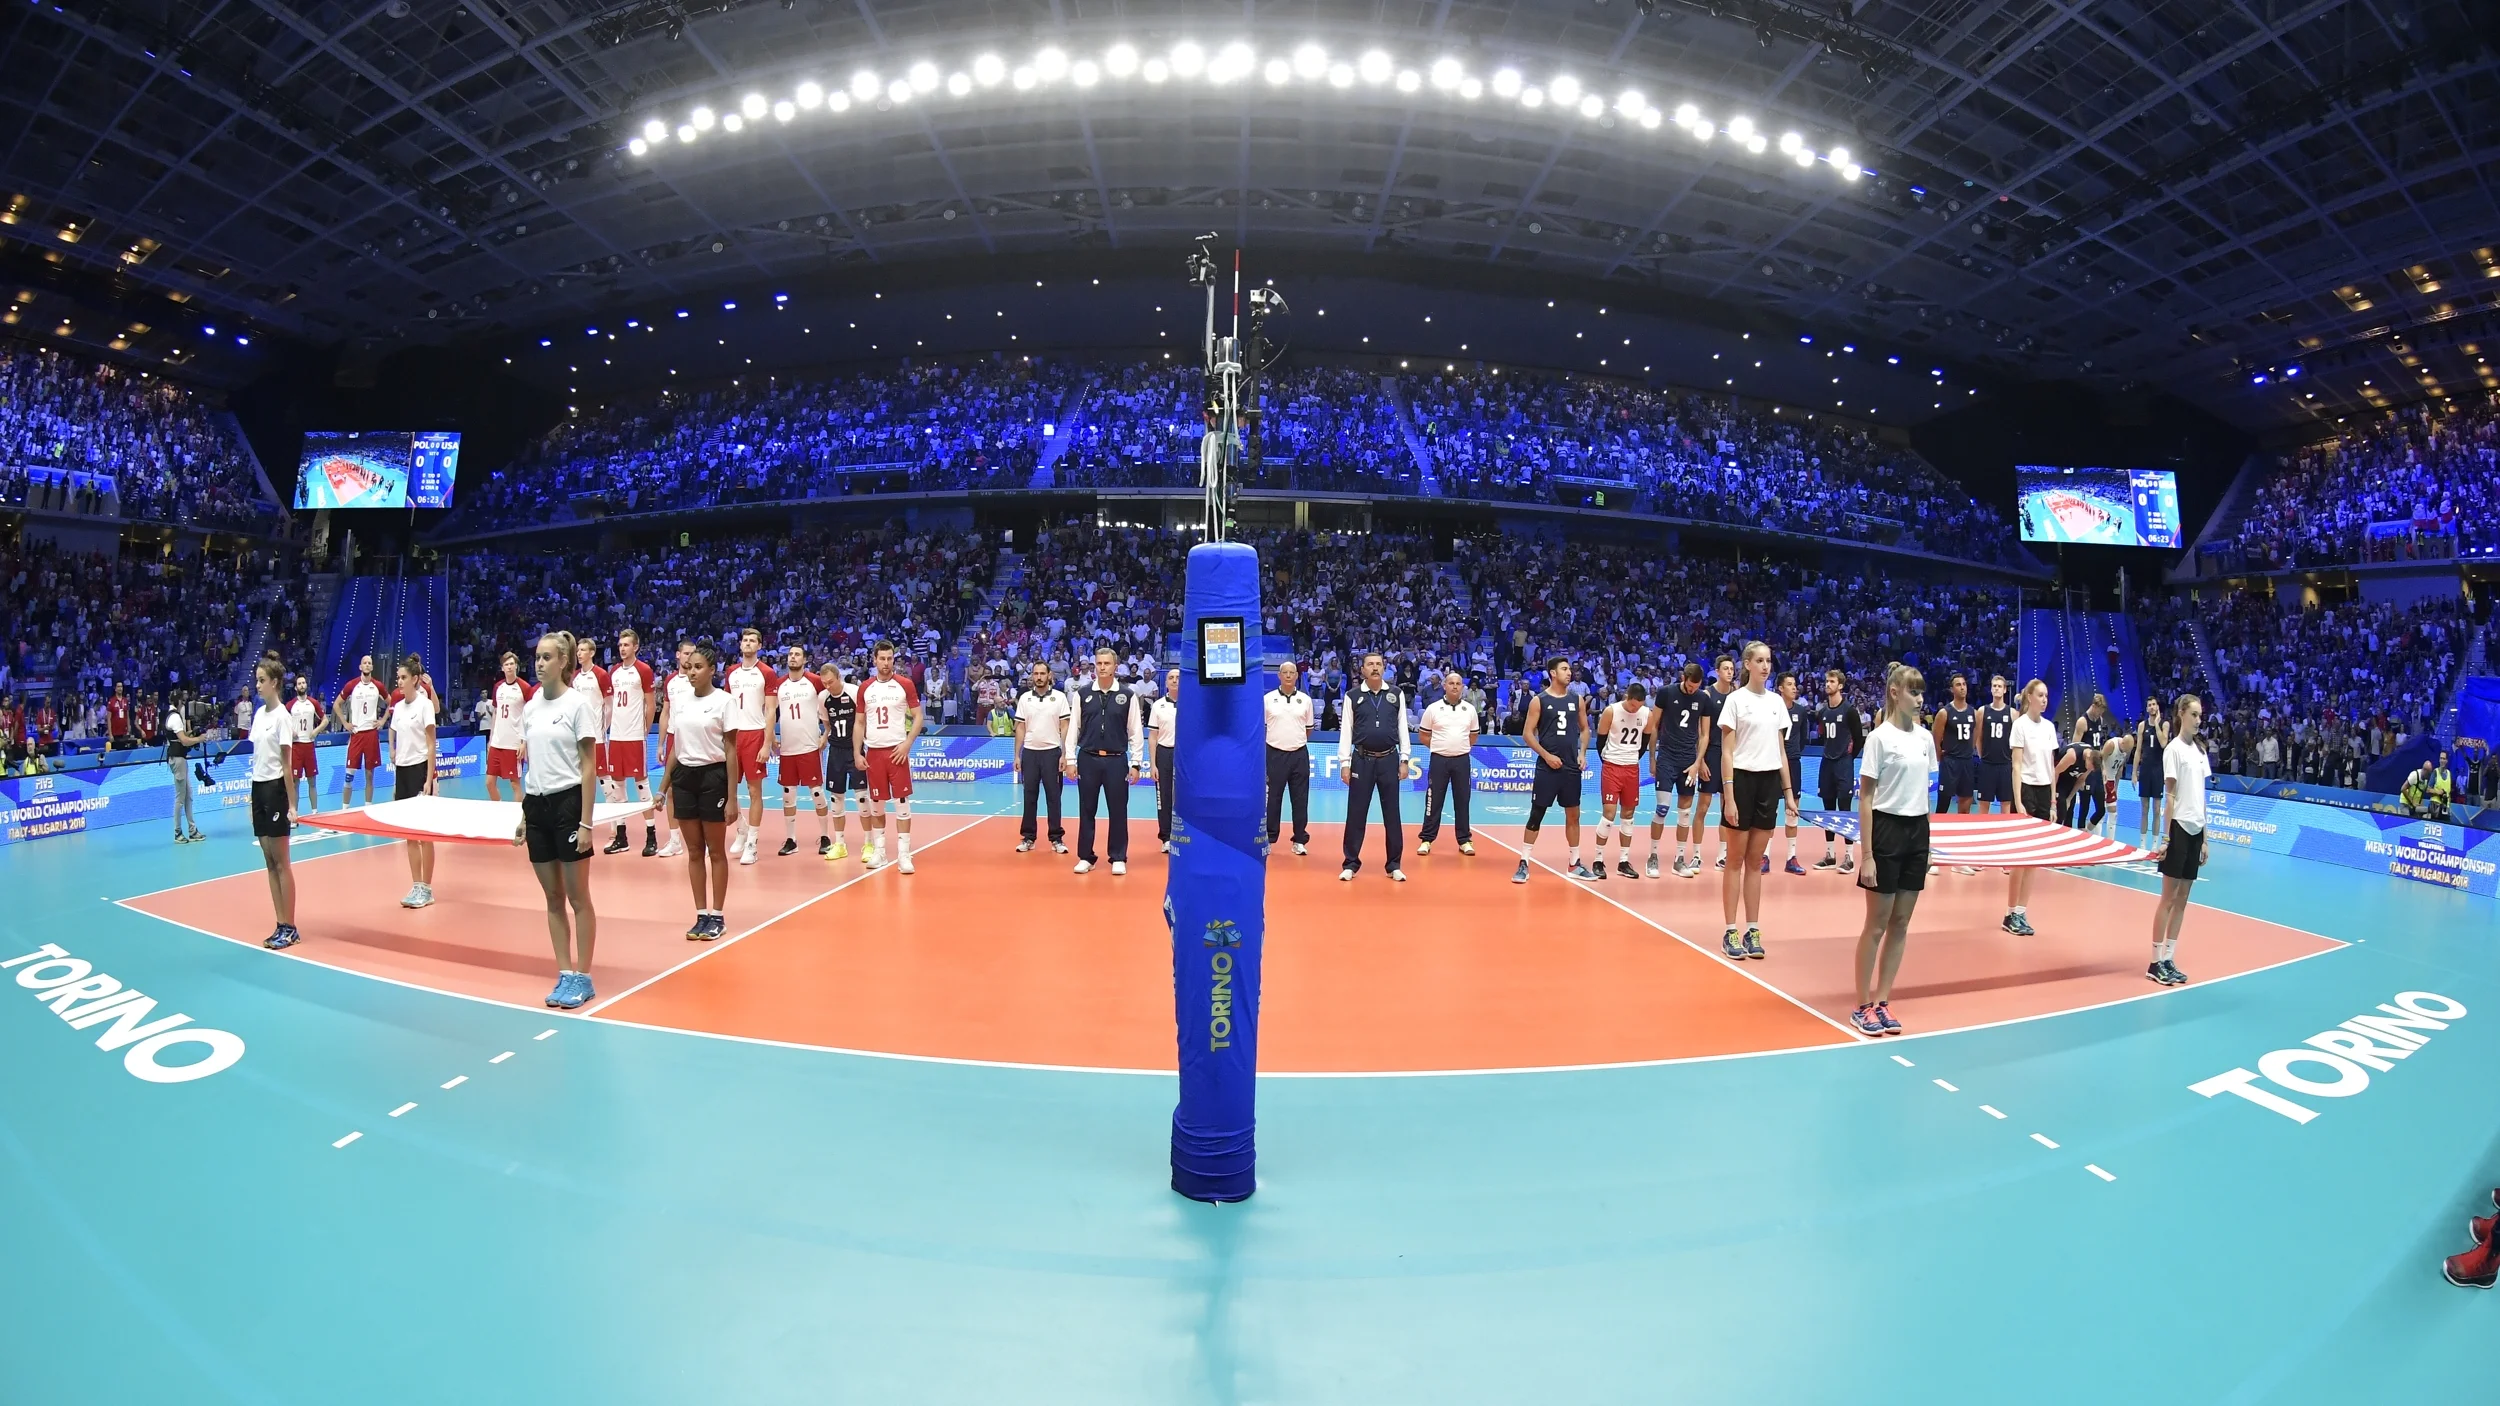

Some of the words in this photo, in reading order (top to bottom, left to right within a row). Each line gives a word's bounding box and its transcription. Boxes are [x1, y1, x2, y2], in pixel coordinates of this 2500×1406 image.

[414, 441, 429, 449] POL
[416, 456, 424, 467] 0
[443, 456, 452, 468] 0
[2132, 479, 2148, 487] POL
[2138, 494, 2147, 506] 0
[2148, 535, 2169, 543] 06:23
[618, 691, 627, 707] 20
[363, 702, 367, 714] 6
[501, 704, 509, 718] 15
[789, 703, 800, 719] 11
[876, 706, 889, 724] 13
[300, 719, 307, 731] 12
[1557, 711, 1567, 729] 3
[1680, 710, 1690, 728] 2
[834, 720, 846, 737] 17
[1825, 722, 1837, 739] 10
[1957, 724, 1971, 740] 13
[1991, 723, 2003, 738] 18
[1620, 728, 1639, 744] 22
[436, 755, 477, 766] HAMPIONSHIP
[910, 758, 926, 767] RLD
[928, 759, 1004, 769] CHAMPIONSHIP
[956, 772, 975, 780] 2018
[1481, 769, 1517, 779] WORLD
[873, 789, 879, 797] 13
[1476, 782, 1533, 791] ITALY-BULGA
[10, 806, 42, 823] WORLD
[43, 796, 110, 818] CHAMPIONSHIP
[69, 817, 86, 829] 2018
[2214, 815, 2277, 834] CHAMPIONSHIP
[2365, 840, 2392, 857] MEN'S
[2395, 845, 2427, 862] WORLD
[2428, 852, 2496, 876] CHAMPIONSHIP
[2451, 874, 2469, 888] 2018
[1210, 952, 1233, 1052] TORINO
[0, 943, 245, 1083] TORINO
[2186, 991, 2467, 1125] TORINO
